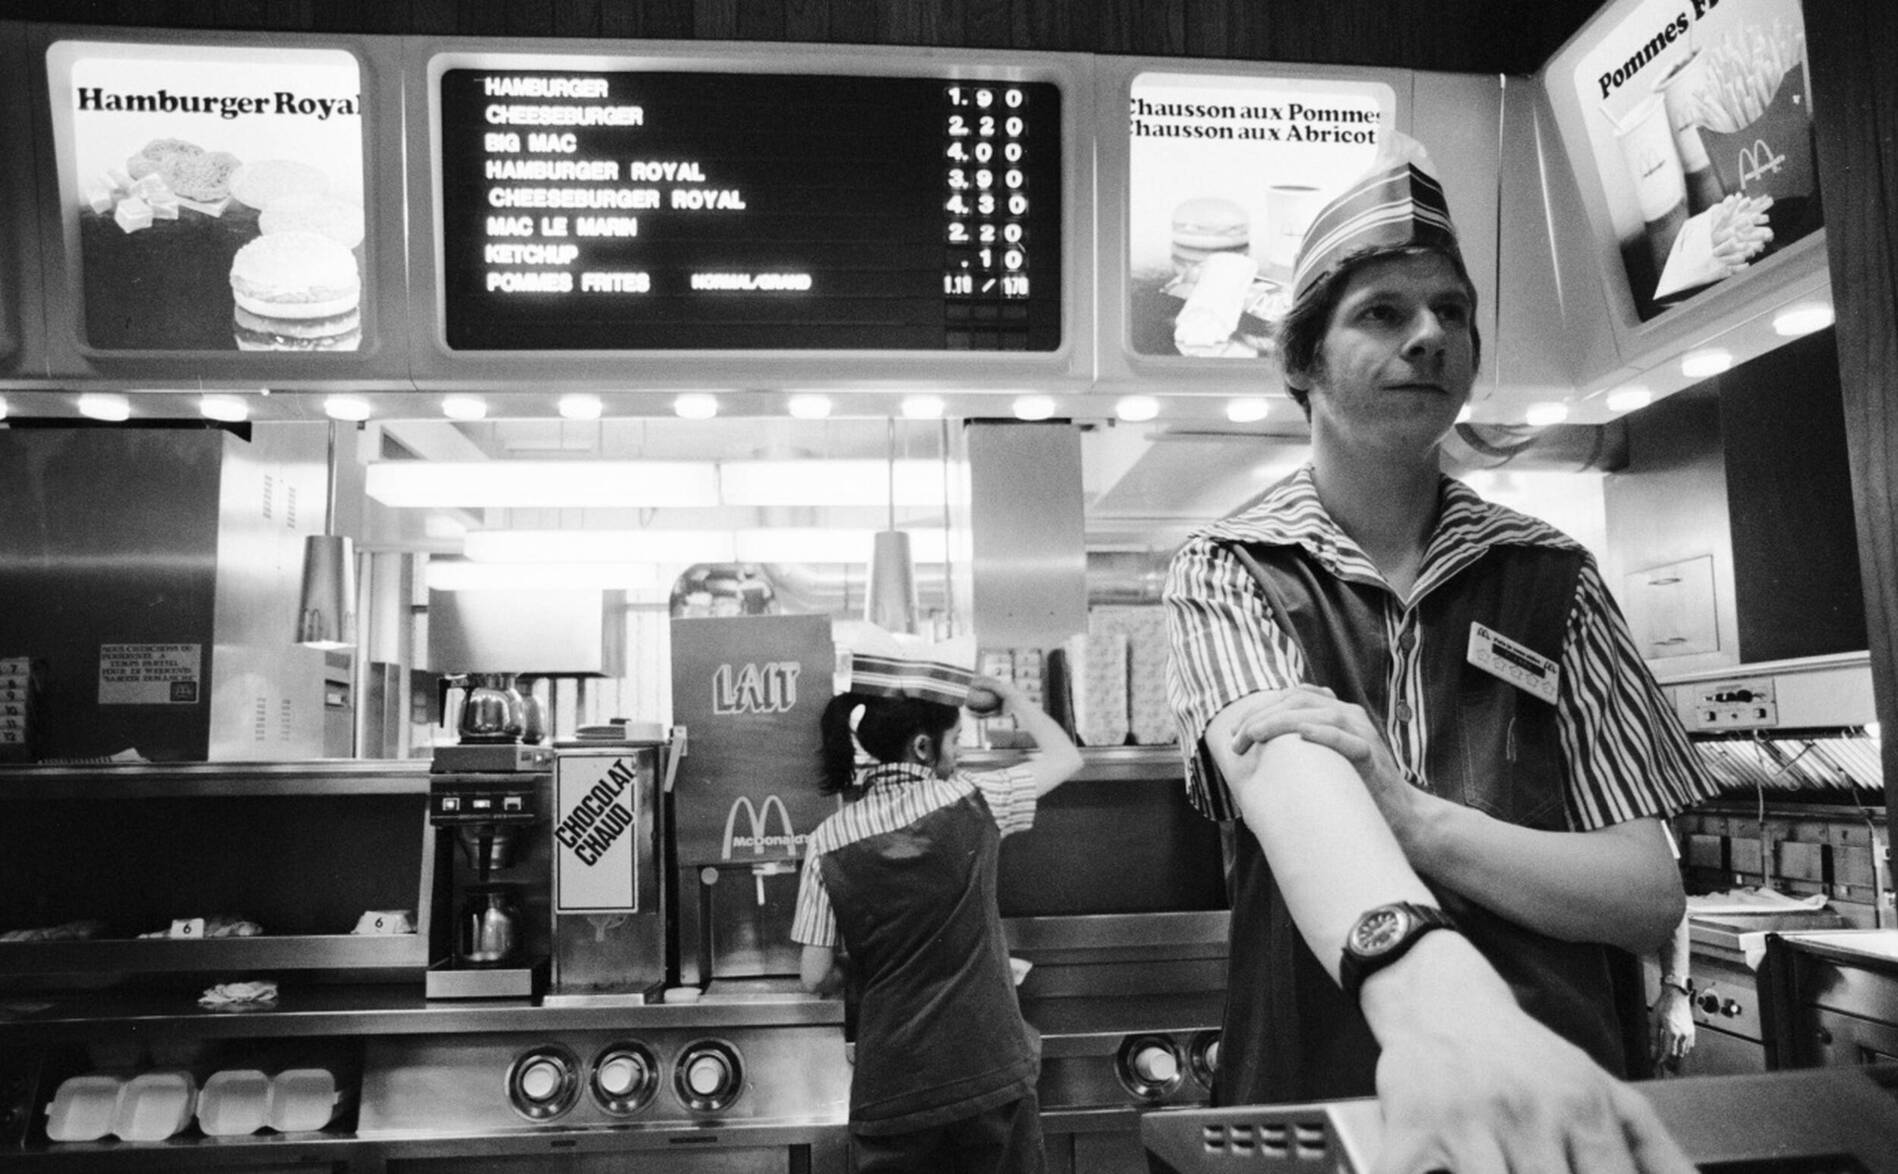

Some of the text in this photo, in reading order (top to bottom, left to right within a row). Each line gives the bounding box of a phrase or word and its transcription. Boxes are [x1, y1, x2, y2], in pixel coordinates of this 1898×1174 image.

[1598, 11, 1689, 100] Pommes
[485, 77, 608, 98] HAMBURGER
[77, 86, 270, 119] Hamburger
[485, 105, 643, 126] CHEESEBURGER
[1240, 106, 1283, 121] aux
[1131, 119, 1234, 140] hausson
[1238, 126, 1281, 142] aux
[485, 133, 520, 153] BIG
[528, 133, 577, 153] MAC
[485, 160, 619, 181] HAMBURGER
[631, 161, 706, 181] ROYAL
[488, 188, 660, 209] CHEESEBURGER
[671, 190, 746, 210] ROYAL
[487, 216, 534, 237] MAC
[541, 217, 568, 237] LE
[576, 217, 638, 237] MARIN
[485, 244, 579, 265] KETCHUP
[487, 272, 573, 292] POMMES
[581, 272, 650, 293] FRITES
[713, 661, 800, 715] LAIT
[554, 758, 635, 849] CHOCOLAT
[574, 803, 634, 867] CHAUD
[183, 922, 192, 934] 6
[374, 916, 384, 929] 6
